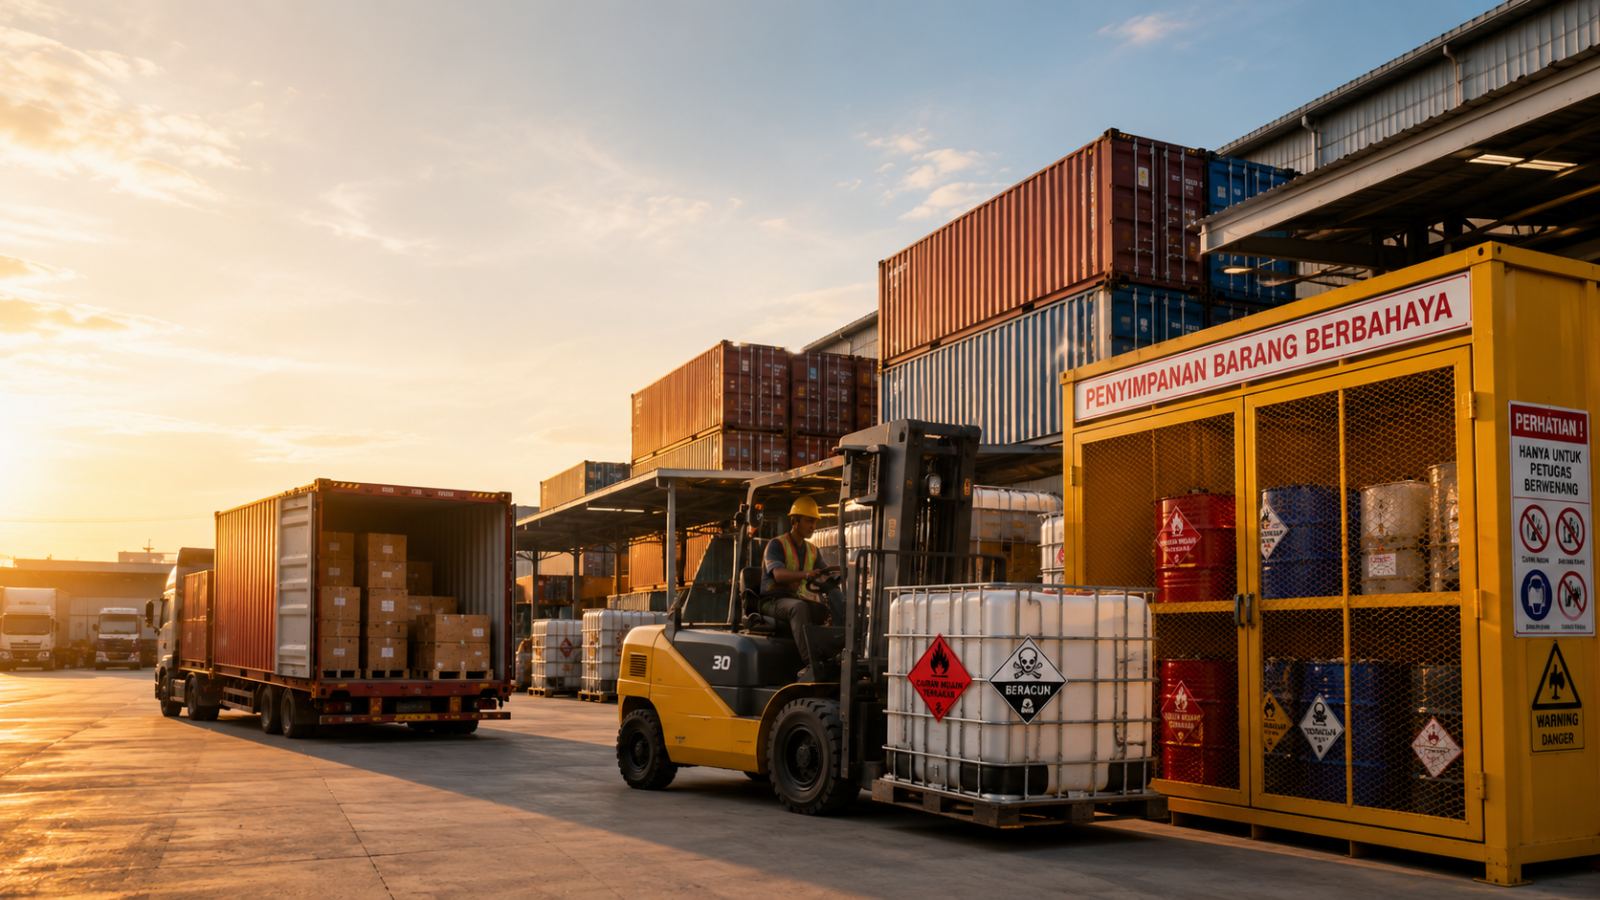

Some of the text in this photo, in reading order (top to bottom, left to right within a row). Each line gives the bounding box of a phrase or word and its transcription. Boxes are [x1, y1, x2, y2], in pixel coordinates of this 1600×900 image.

[1086, 292, 1453, 410] PENYIMPANAN BARANG BERBAHAYA
[1515, 412, 1577, 437] PERHATIAN
[1519, 445, 1582, 464] HANYA UNTUK
[1530, 462, 1572, 479] PETUGAS
[1524, 478, 1579, 496] BERWENANG
[712, 655, 731, 670] 30
[1005, 684, 1051, 696] BERACUN
[1536, 713, 1579, 728] WARNING
[1541, 732, 1575, 746] DANGER
